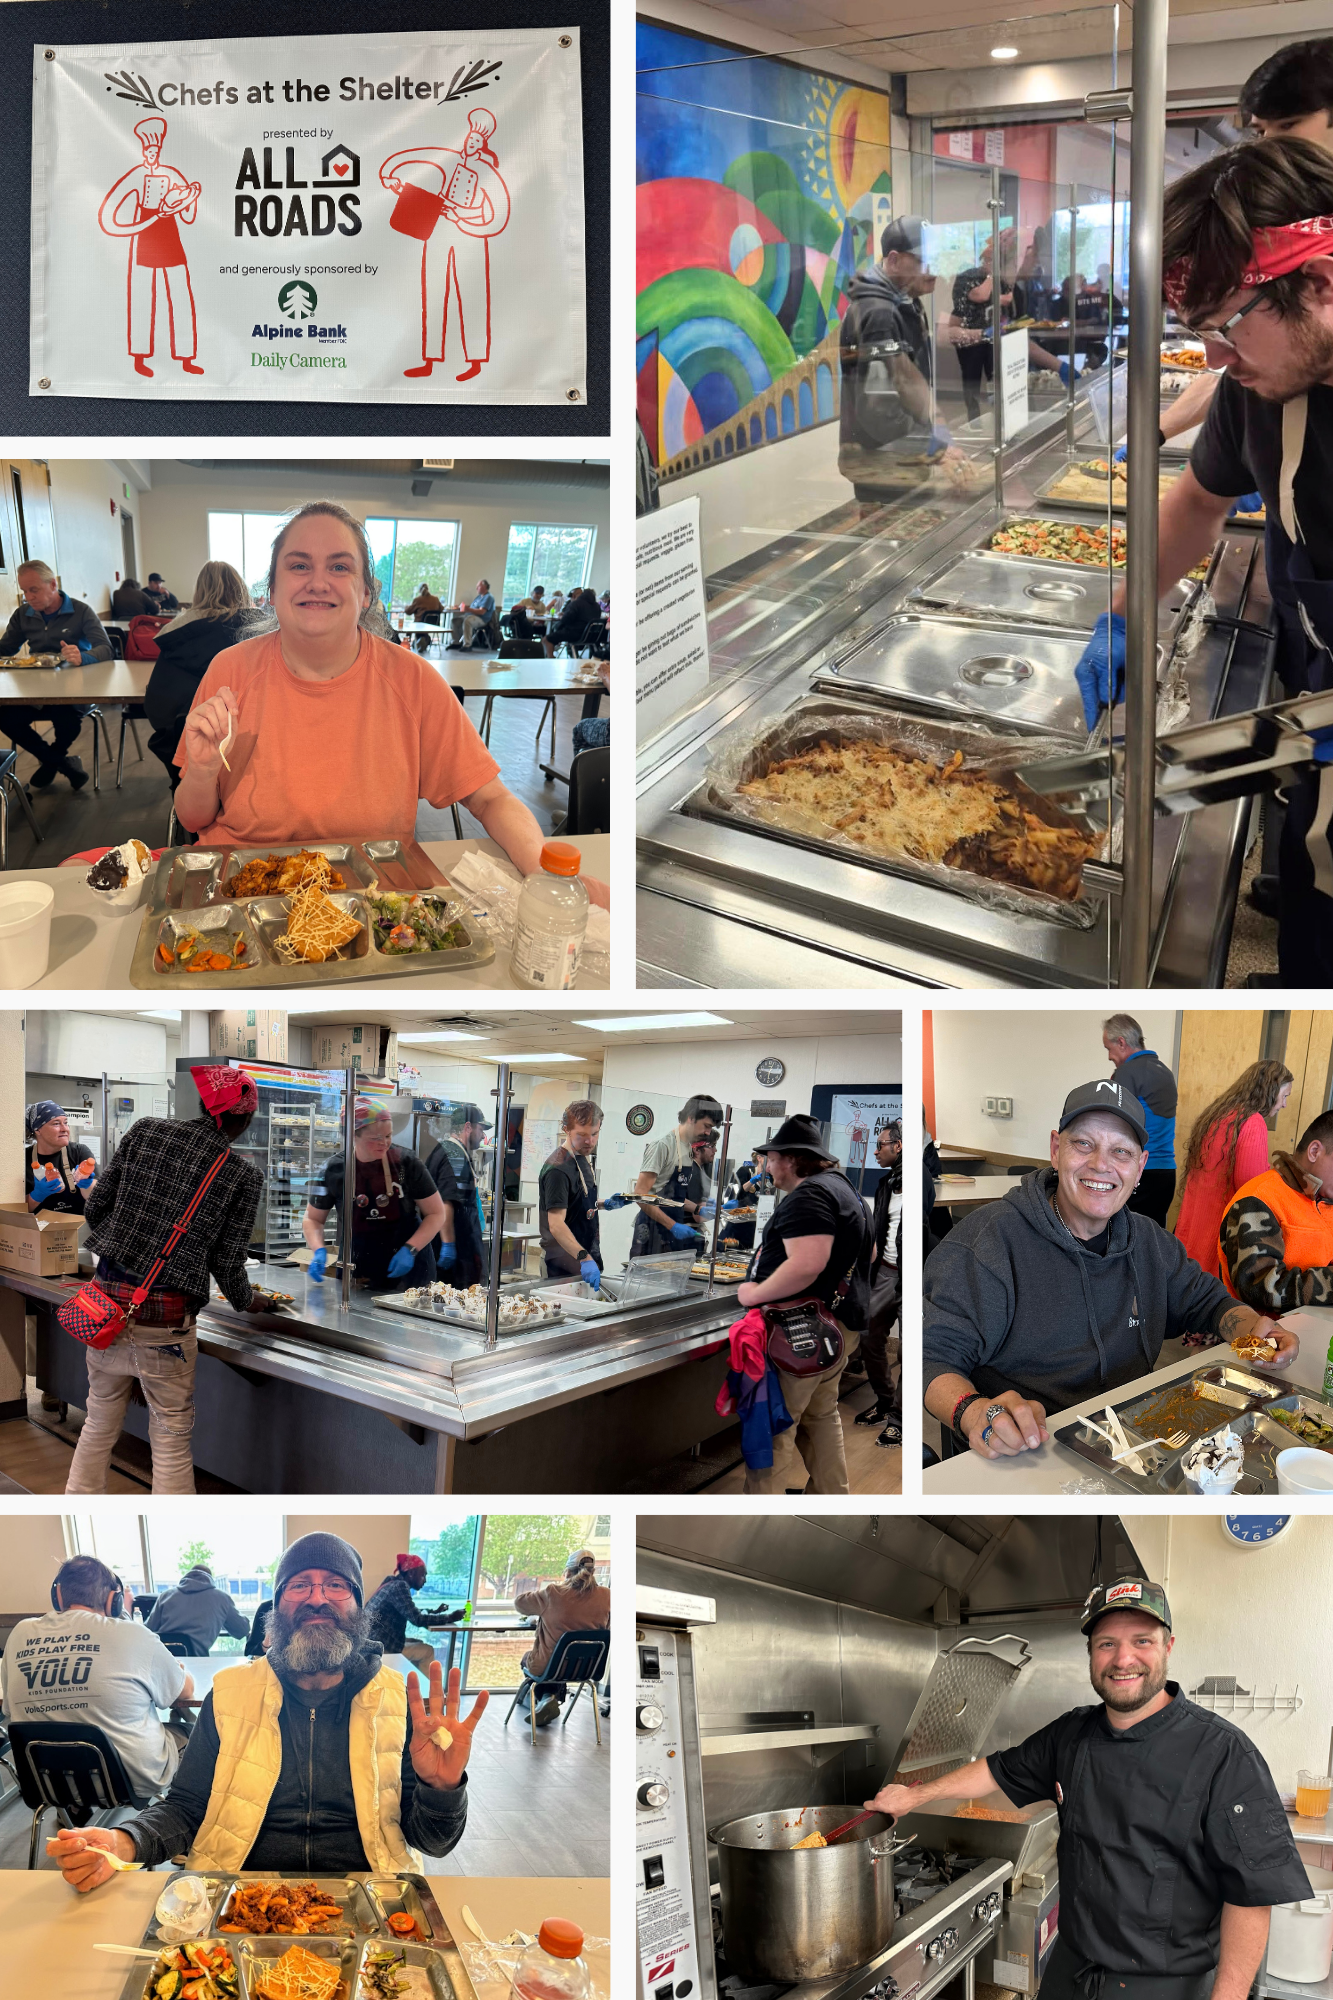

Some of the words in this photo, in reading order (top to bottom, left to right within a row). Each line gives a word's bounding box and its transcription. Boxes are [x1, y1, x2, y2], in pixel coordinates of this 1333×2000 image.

[158, 80, 239, 106] Chefs
[246, 81, 274, 104] at
[282, 79, 330, 103] the
[339, 75, 445, 101] Shelter
[263, 128, 317, 140] presented
[320, 128, 333, 139] by
[235, 146, 308, 190] ALL
[235, 193, 362, 237] ROADS
[219, 264, 238, 274] and
[242, 264, 301, 276] generously
[304, 264, 361, 276] sponsored
[364, 264, 378, 275] by
[251, 324, 303, 340] Alpine
[308, 324, 347, 338] Bank
[250, 352, 288, 370] Daily
[289, 352, 347, 368] Camera
[1275, 1518, 1283, 1526] 4
[1241, 1531, 1249, 1539] 7
[1253, 1532, 1261, 1540] 6
[1266, 1528, 1274, 1536] 5
[26, 1637, 41, 1646] WE
[43, 1635, 72, 1644] PLAY
[16, 1648, 35, 1659] KIDS
[37, 1645, 67, 1654] PLAY
[70, 1644, 100, 1652] FREE
[18, 1657, 93, 1689] VOLO
[45, 1686, 89, 1694] FOUNDATION
[25, 1702, 88, 1714] VoloSports.com
